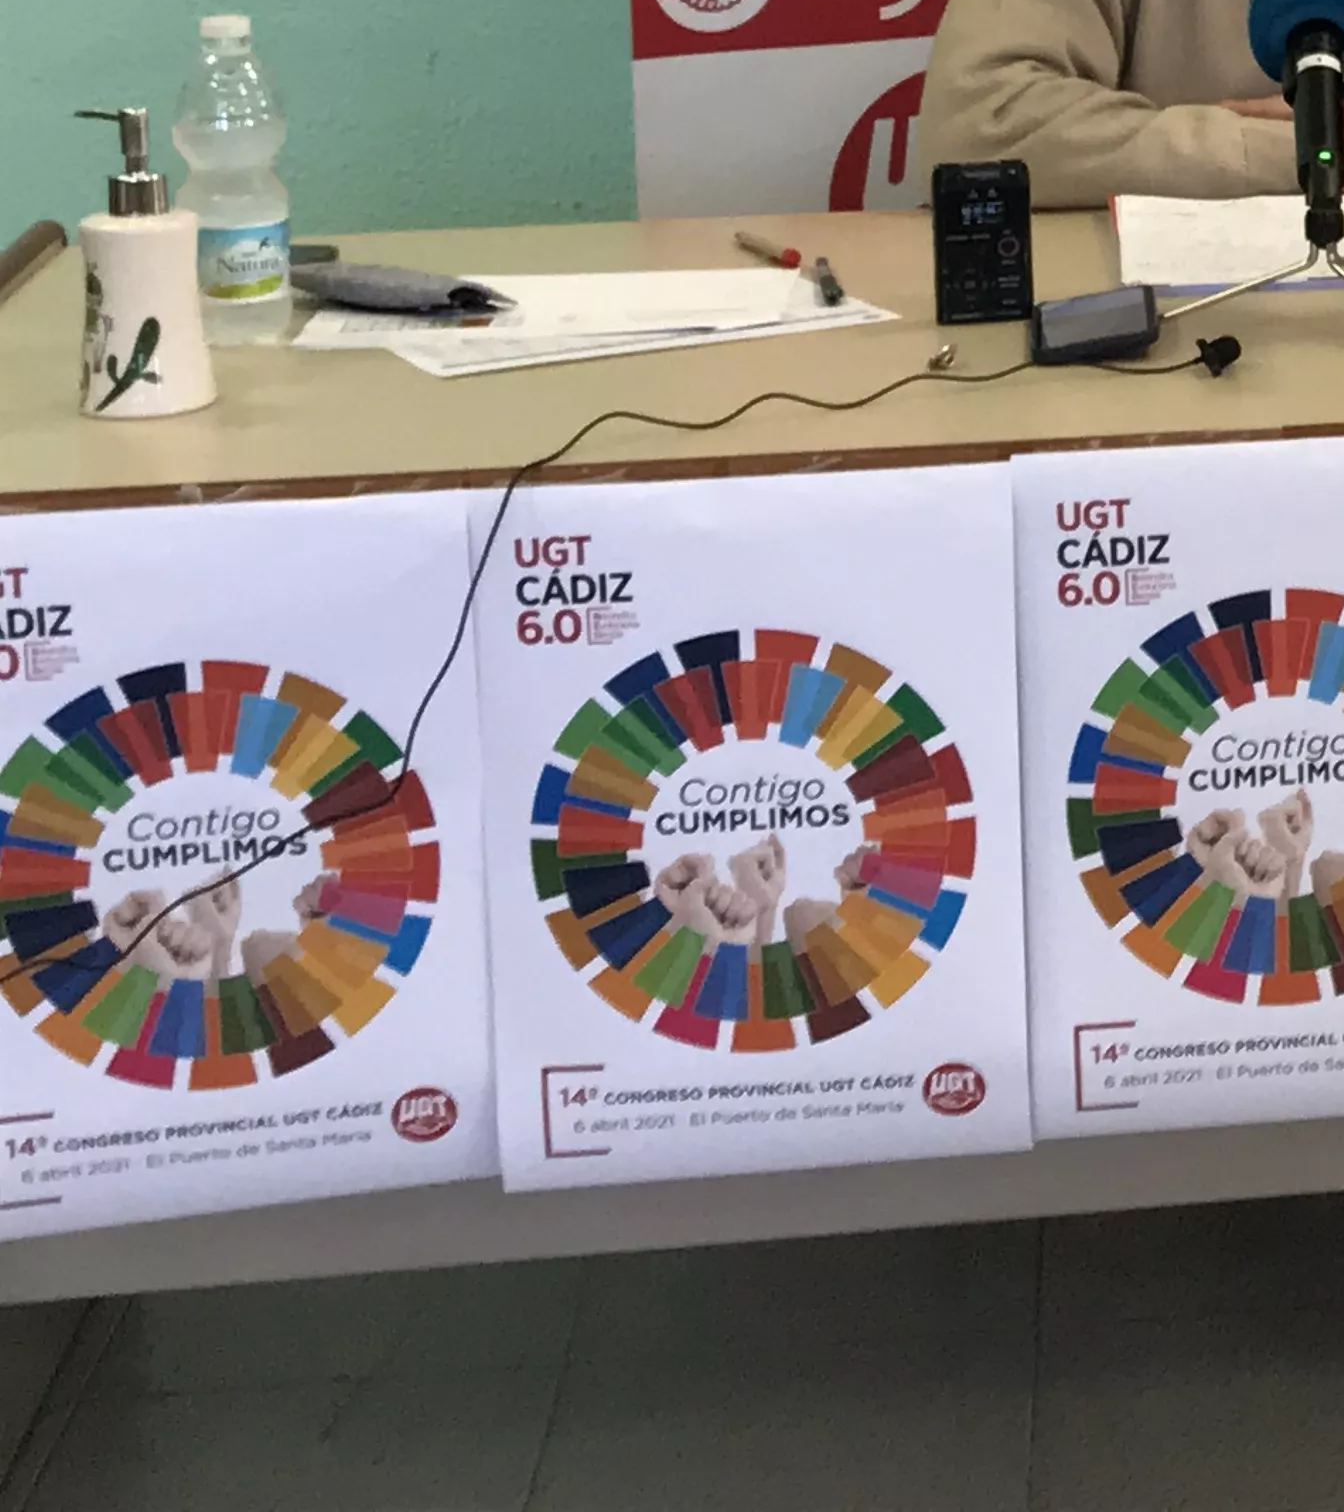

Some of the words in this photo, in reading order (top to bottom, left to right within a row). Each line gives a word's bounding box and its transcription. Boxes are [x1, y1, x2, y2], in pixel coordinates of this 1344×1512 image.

[1056, 499, 1130, 530] UGT
[515, 536, 591, 567] UGT
[1057, 533, 1169, 568] CÁDIZ
[516, 568, 633, 606] CÁDIZ
[1058, 572, 1119, 606] 6.0
[517, 610, 582, 644] 6.0
[680, 778, 825, 807] Contigo
[127, 807, 279, 842] Contigo
[655, 804, 850, 835] CUMPLIMOS
[103, 836, 308, 873] CUMPLIMOS
[1134, 1040, 1230, 1061] CONGRESO
[1235, 1032, 1337, 1053] PROVINCIAL
